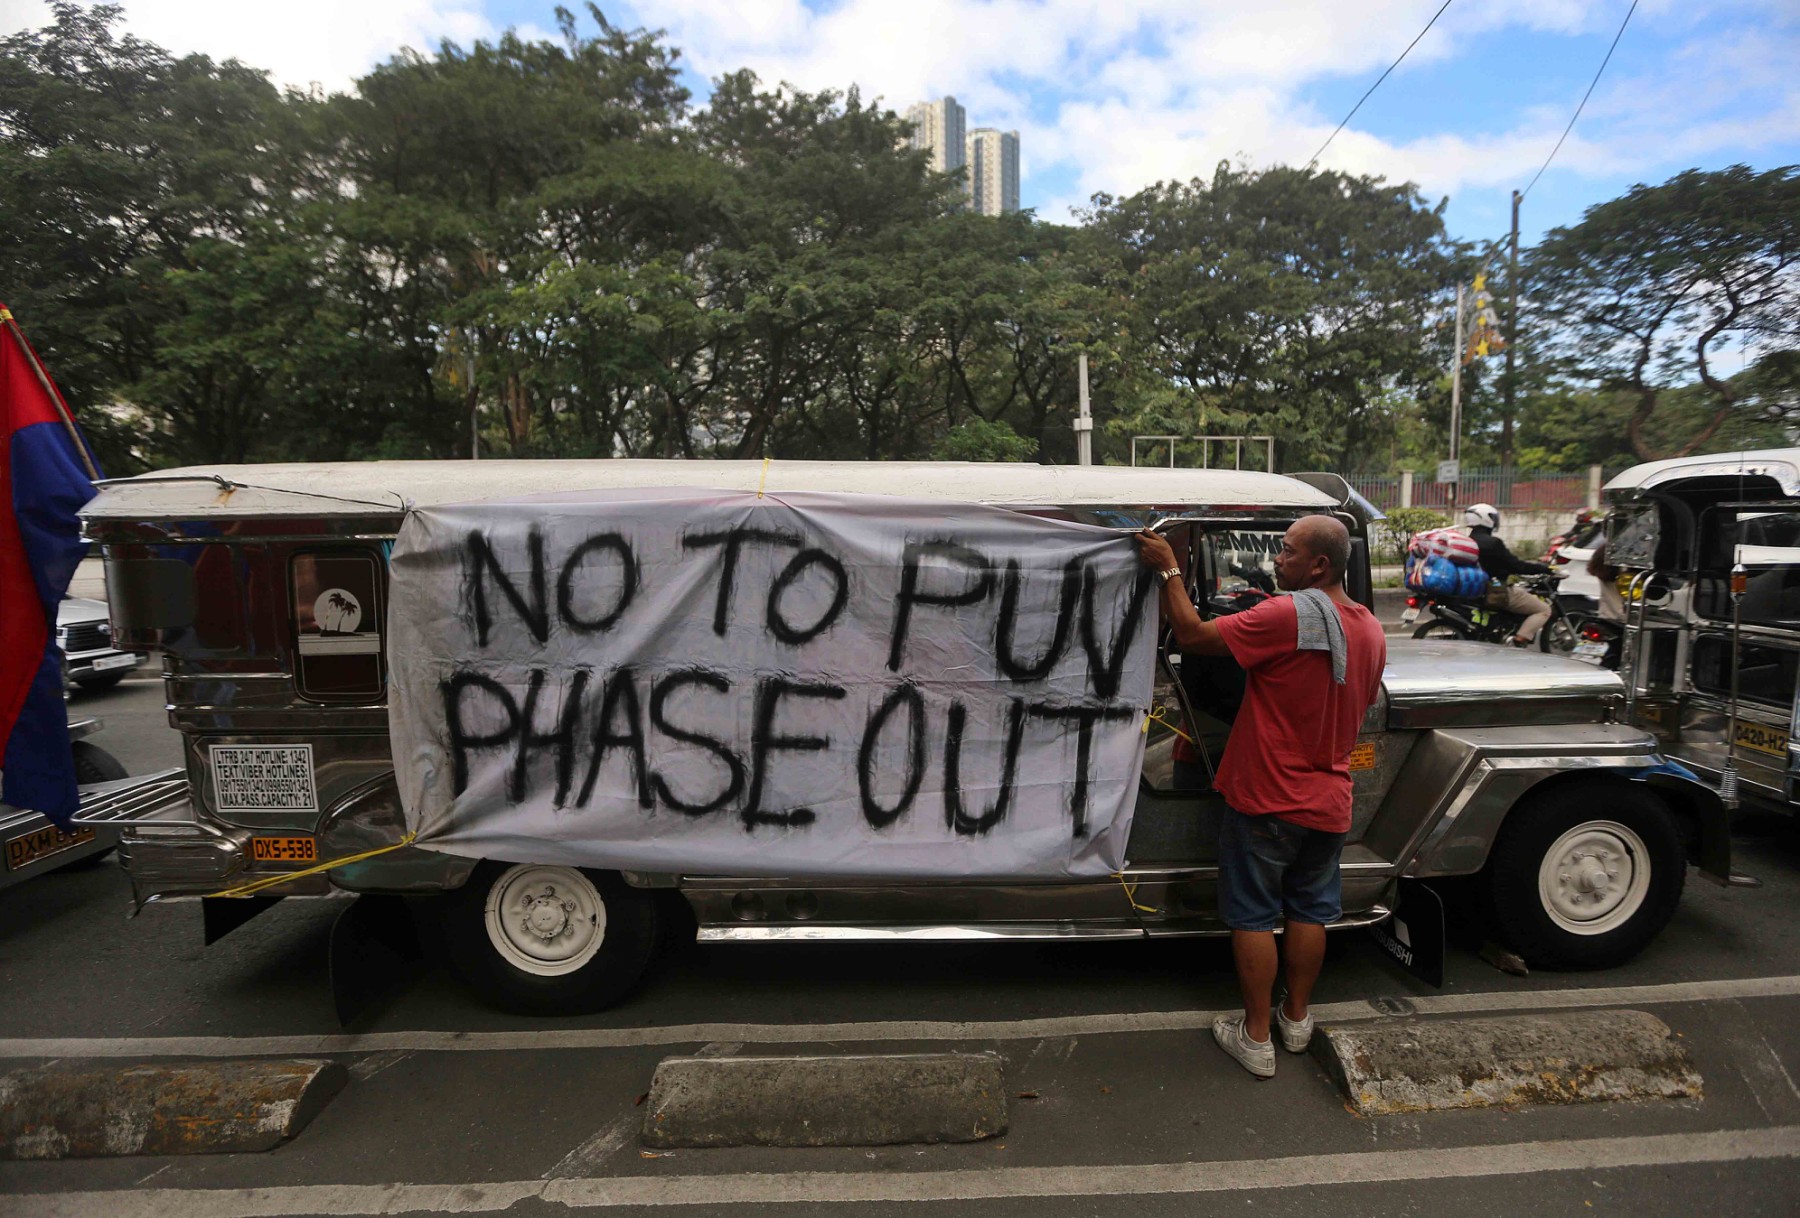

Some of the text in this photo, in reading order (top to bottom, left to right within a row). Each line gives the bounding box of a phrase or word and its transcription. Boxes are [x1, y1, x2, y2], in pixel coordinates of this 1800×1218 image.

[460, 524, 1156, 700] NO TO PUV
[290, 750, 307, 764] 1342
[440, 662, 1136, 838] PHASE OUT
[265, 764, 308, 778] HOTLINES:
[303, 793, 313, 806] 21
[255, 839, 314, 858] DXS-538
